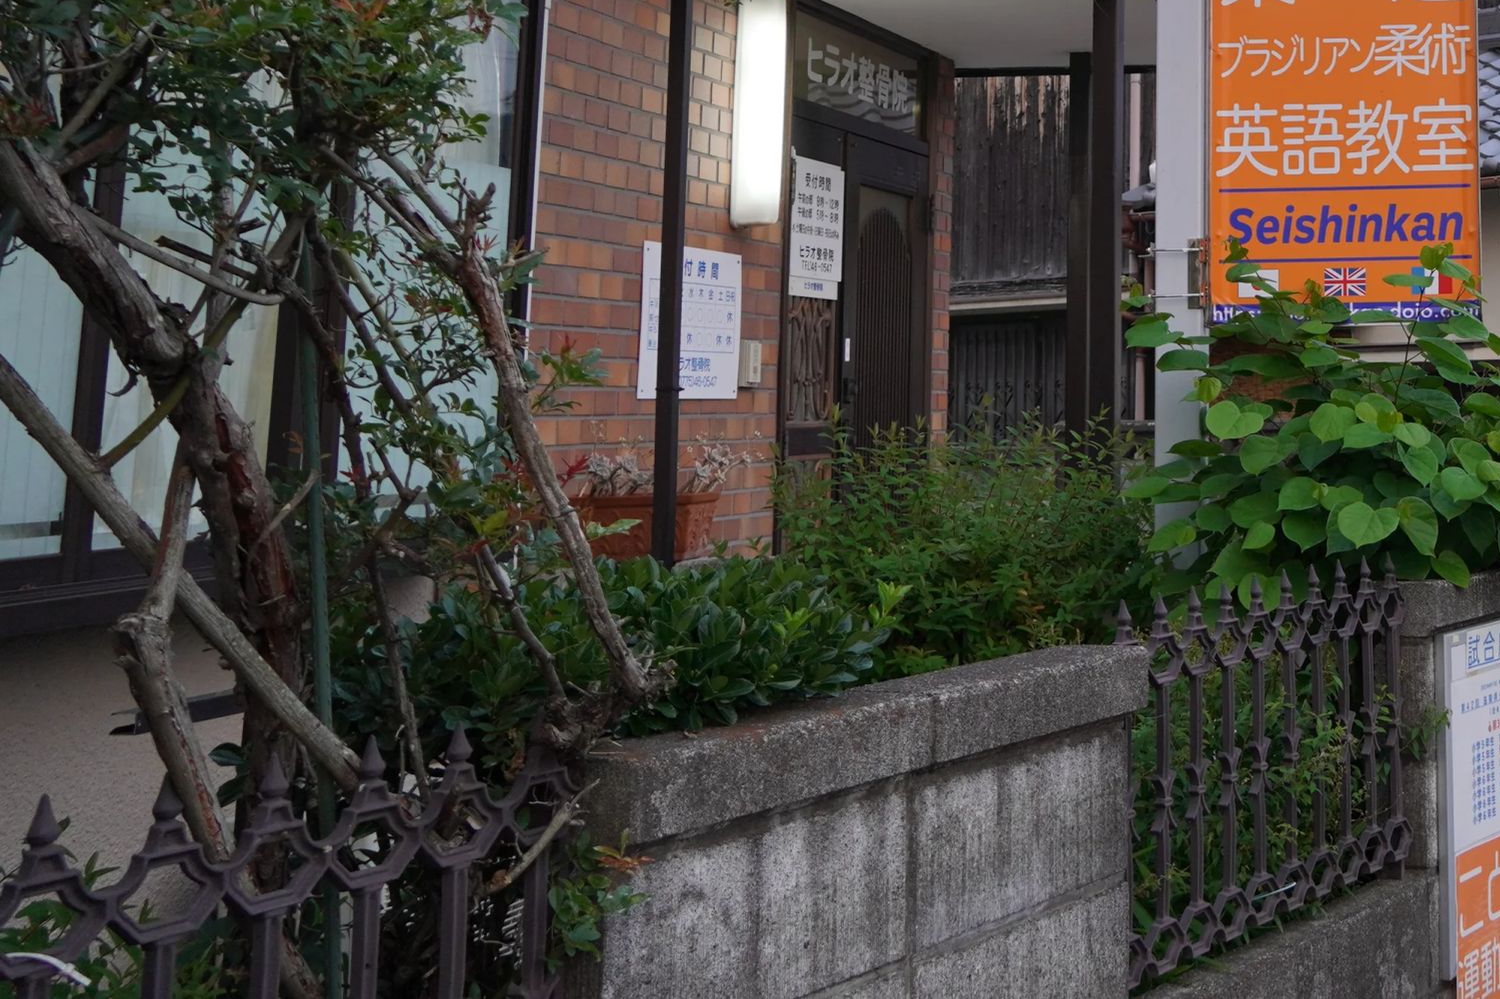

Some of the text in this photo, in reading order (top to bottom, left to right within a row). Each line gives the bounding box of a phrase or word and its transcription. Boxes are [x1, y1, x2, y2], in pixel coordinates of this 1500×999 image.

[1217, 22, 1472, 78] ブラジリアン柔術
[807, 36, 908, 115] ヒラオ整骨院
[1215, 97, 1474, 178] 英語教室
[805, 172, 832, 192] 受付時間
[1228, 203, 1464, 246] Seishinkan
[800, 245, 834, 262] ヒラオ整骨院
